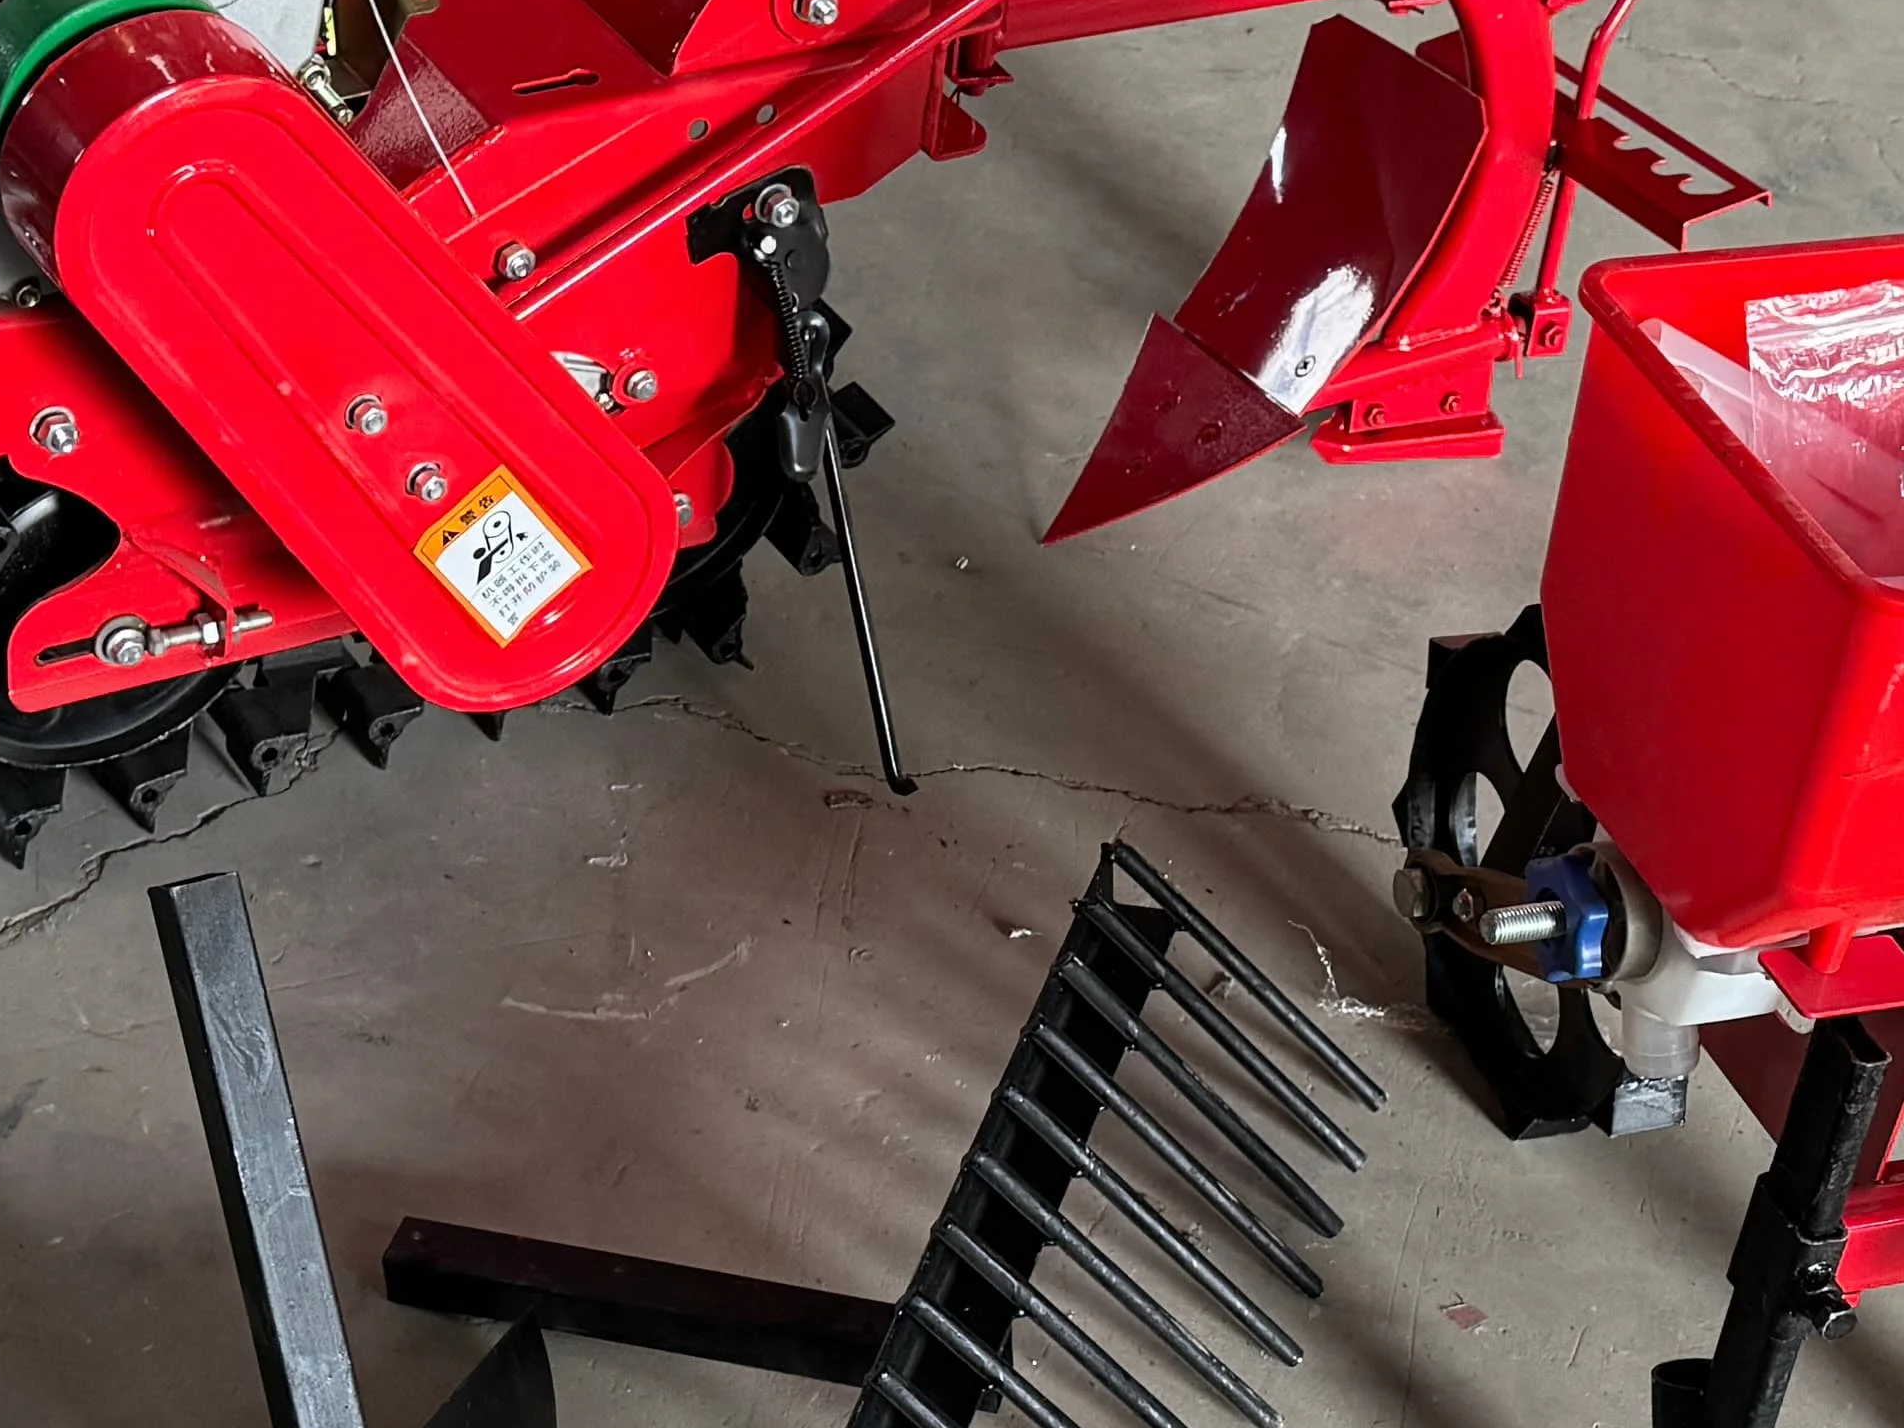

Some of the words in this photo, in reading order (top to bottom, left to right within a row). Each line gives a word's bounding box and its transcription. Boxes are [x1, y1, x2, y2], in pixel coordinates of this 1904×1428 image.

[459, 494, 495, 526] 警告
[481, 541, 546, 600] 机器工作时
